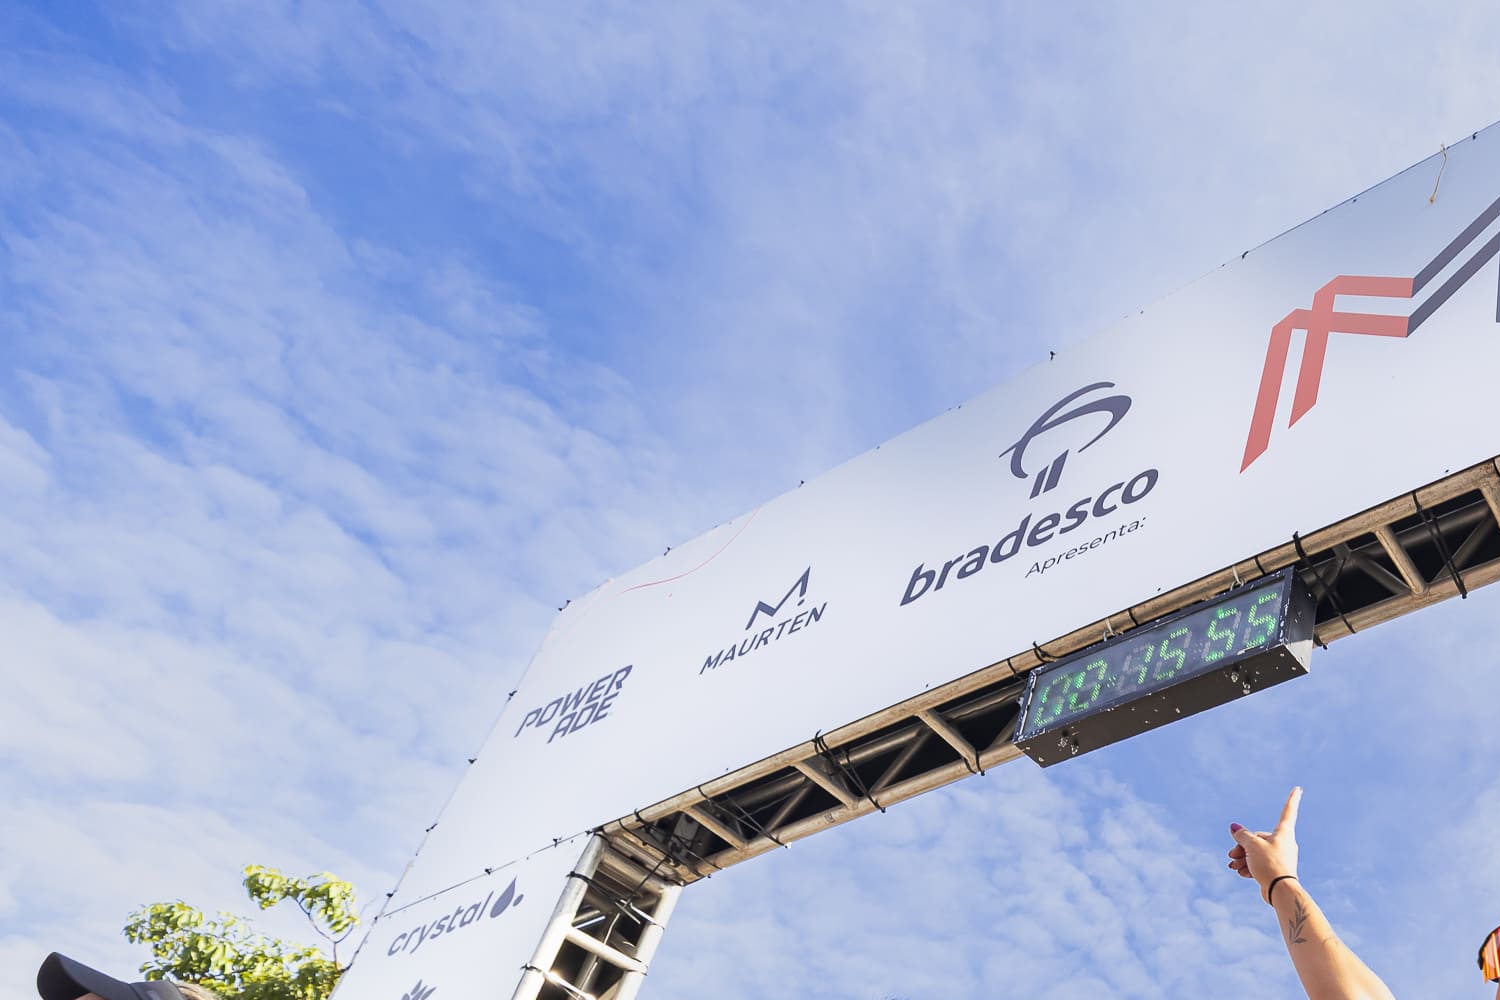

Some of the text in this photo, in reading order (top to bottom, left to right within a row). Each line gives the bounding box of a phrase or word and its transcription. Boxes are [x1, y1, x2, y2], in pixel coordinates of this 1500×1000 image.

[900, 468, 1160, 607] bradesco
[1024, 516, 1147, 578] Apresenta:
[700, 602, 827, 675] MAURTEN
[514, 664, 633, 738] POWER
[547, 691, 620, 744] ADE
[387, 890, 494, 956] crystal
